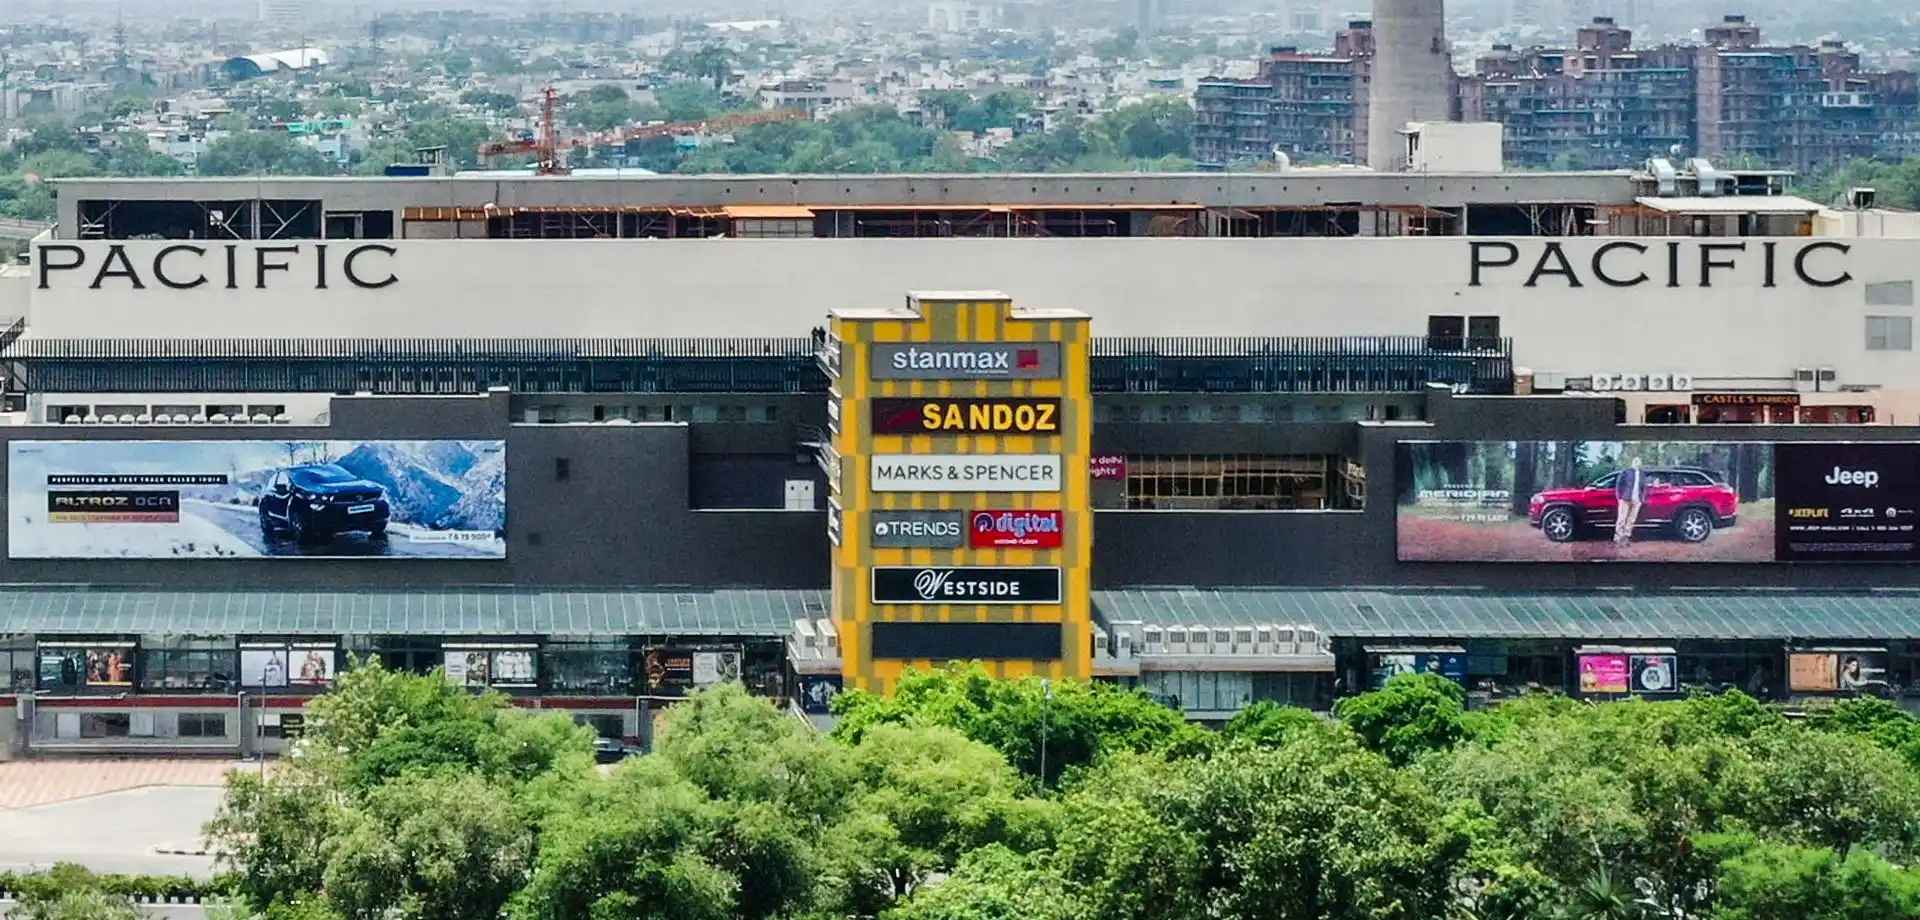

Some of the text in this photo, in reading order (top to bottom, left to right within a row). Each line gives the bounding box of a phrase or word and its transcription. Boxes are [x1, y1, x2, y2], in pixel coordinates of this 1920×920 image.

[37, 244, 399, 290] PACIFIC
[1467, 241, 1853, 288] PACIFIC
[892, 347, 1009, 369] stanmax
[1703, 395, 1754, 403] CASTLE'S
[922, 403, 1056, 431] SANDOZ
[877, 465, 1053, 480] MARKS & SPENCER
[1825, 466, 1879, 488] Jeep
[55, 496, 129, 506] ALTROZ
[888, 522, 960, 536] TRENDS
[996, 512, 1058, 538] digital
